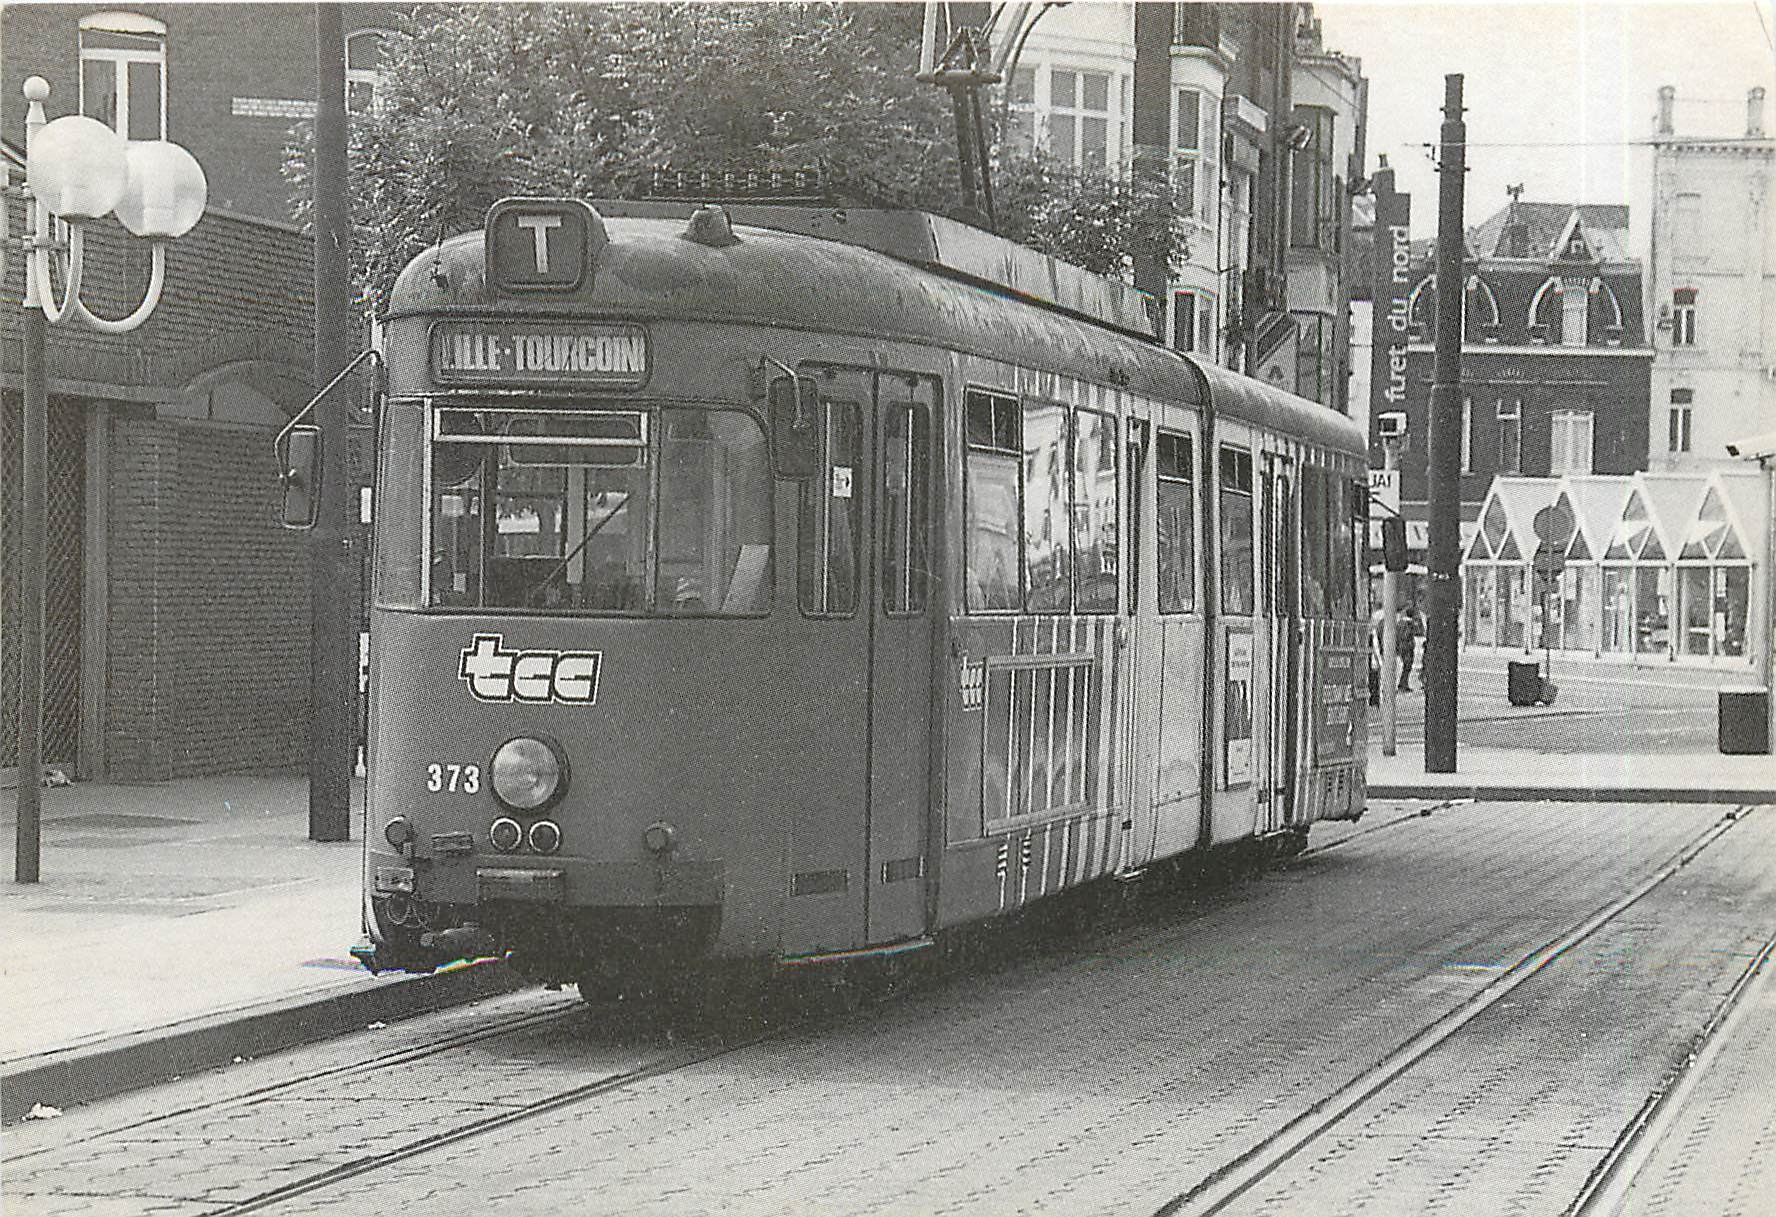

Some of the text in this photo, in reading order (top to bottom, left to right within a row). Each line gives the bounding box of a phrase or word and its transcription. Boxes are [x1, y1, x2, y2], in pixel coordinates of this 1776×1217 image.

[517, 215, 562, 274] T
[1385, 224, 1411, 402] furet du nord
[458, 633, 602, 706] tcc
[427, 763, 480, 794] 373
